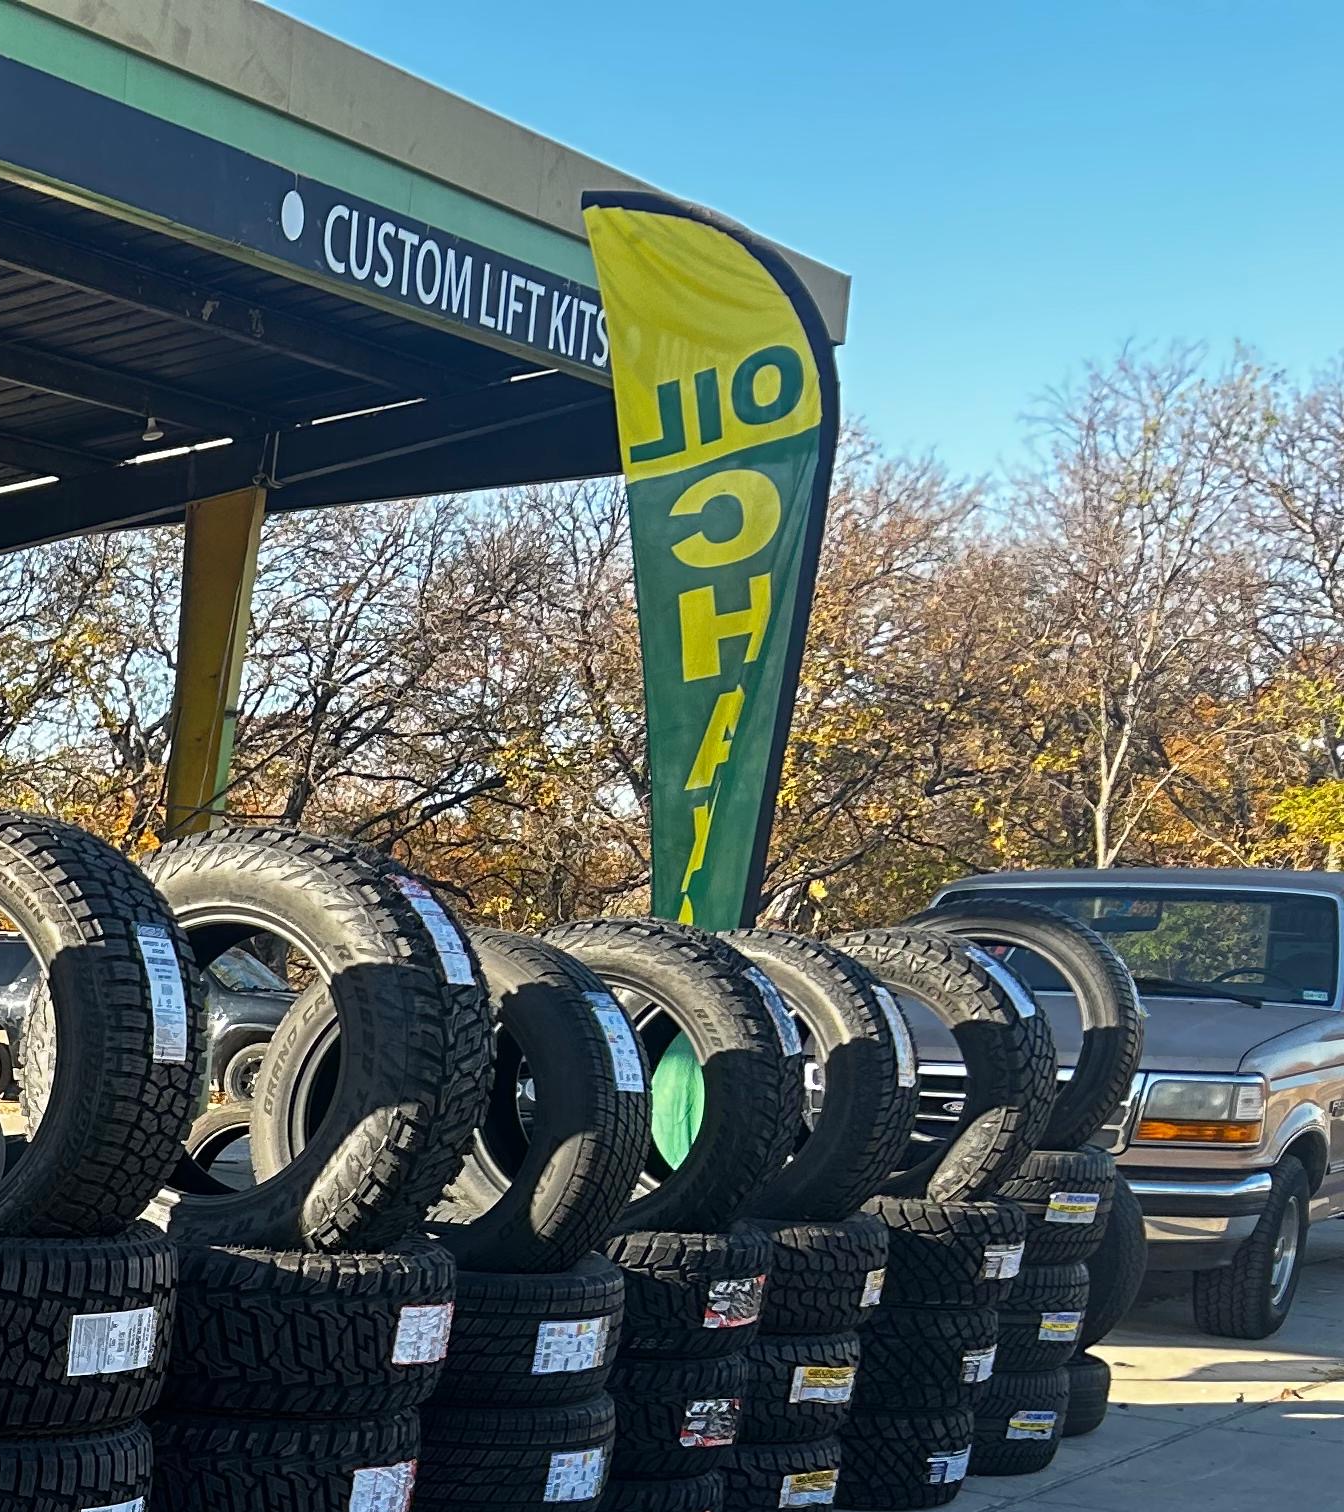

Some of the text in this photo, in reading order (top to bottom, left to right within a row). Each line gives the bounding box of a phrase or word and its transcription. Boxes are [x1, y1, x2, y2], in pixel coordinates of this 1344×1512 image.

[324, 204, 472, 318] CUSTOM
[479, 262, 545, 342] LIFT
[549, 290, 610, 367] KITS
[263, 1025, 298, 1117] GRAND
